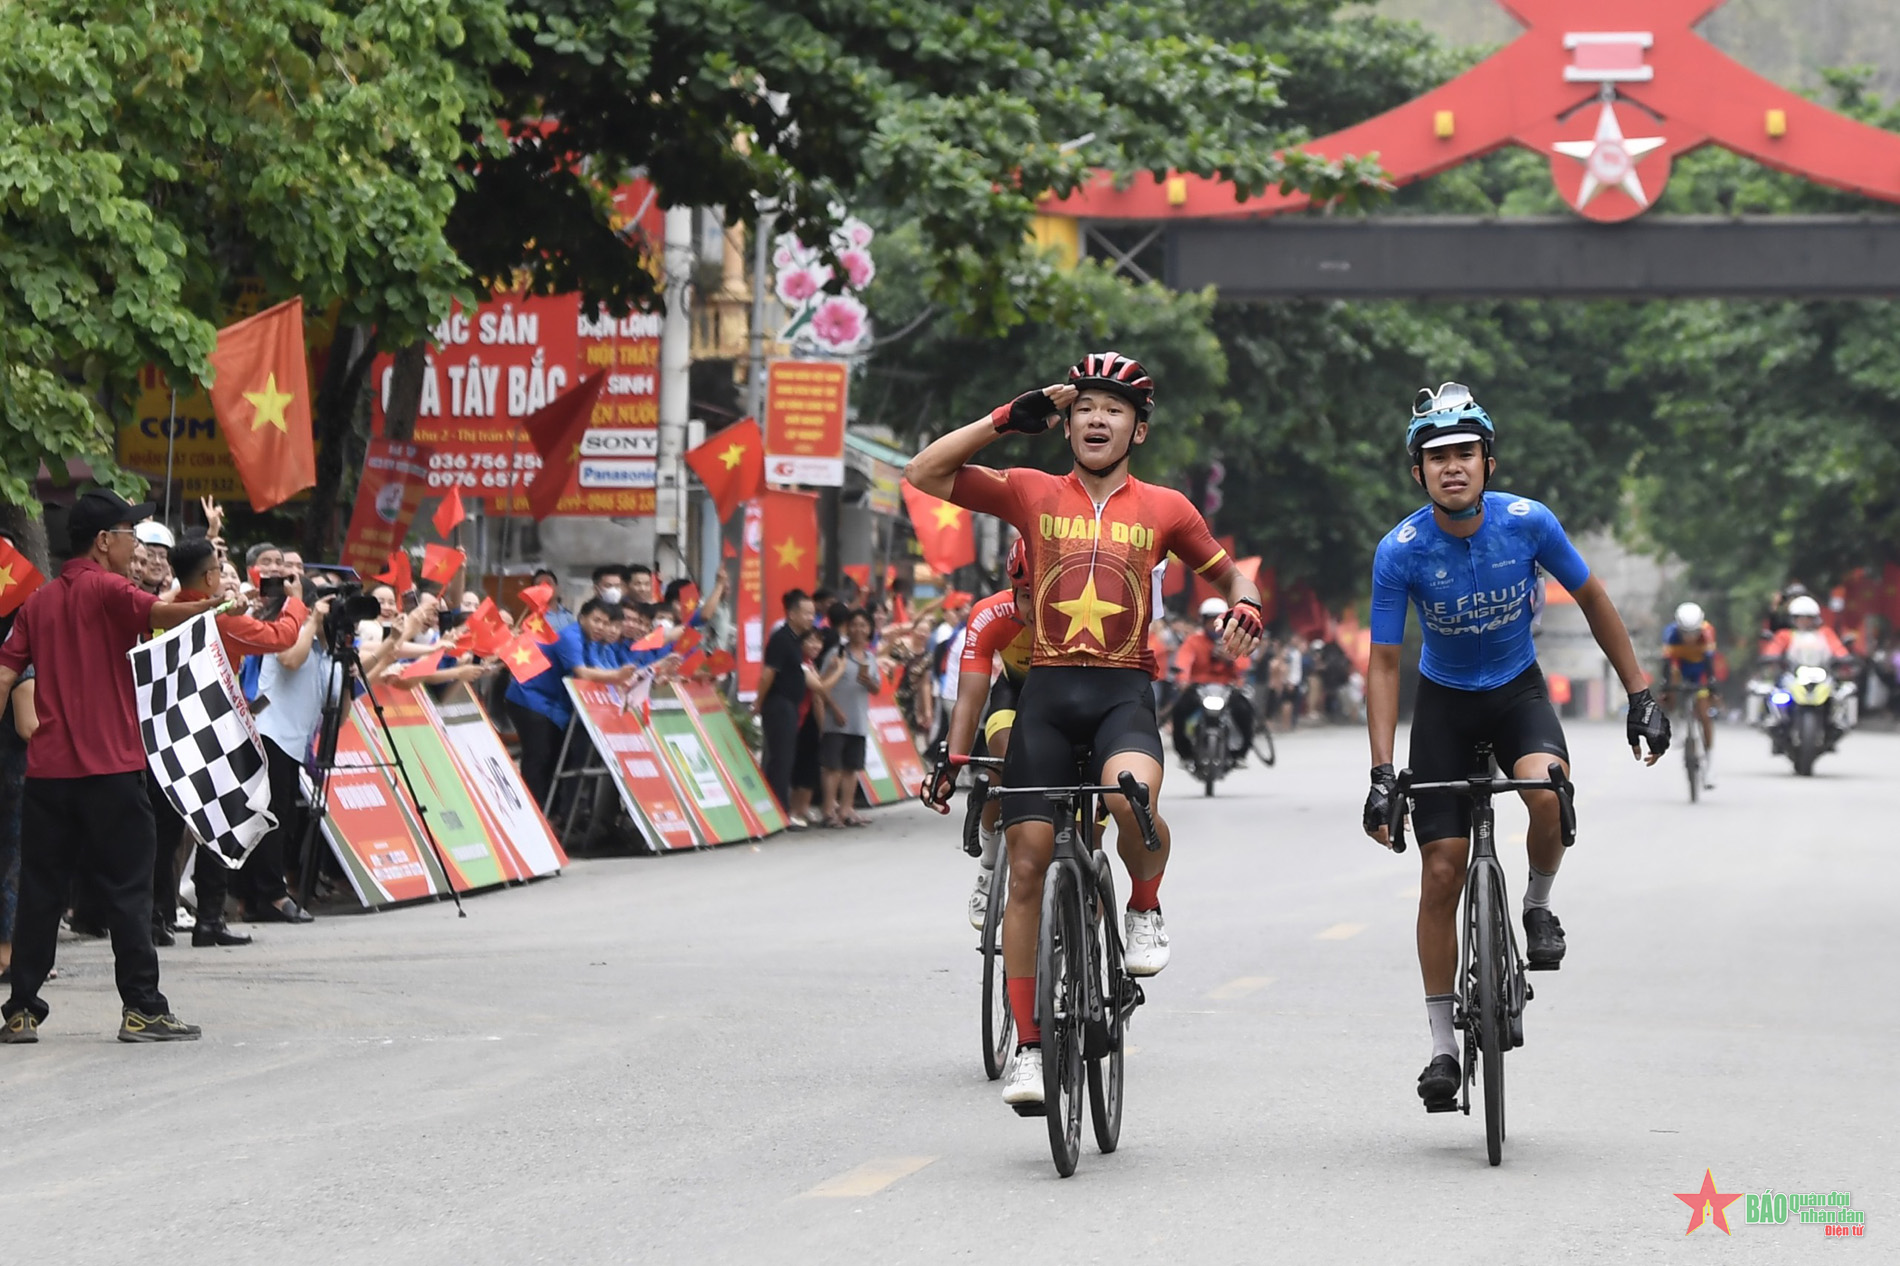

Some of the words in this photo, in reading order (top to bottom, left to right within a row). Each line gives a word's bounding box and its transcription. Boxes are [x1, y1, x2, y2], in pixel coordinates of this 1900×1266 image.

[480, 302, 539, 345] SẢN
[447, 354, 500, 418] TÂY
[507, 347, 567, 418] BẮC
[606, 373, 655, 397] SINH
[140, 415, 215, 440] CƠM
[586, 436, 658, 450] SONY
[428, 453, 467, 469] 036
[470, 453, 507, 469] 756
[427, 471, 477, 487] 0976
[1040, 513, 1101, 541] QUÂN
[1111, 522, 1154, 551] ĐỘI
[1422, 600, 1447, 614] LE
[1456, 577, 1528, 611] FRUIT
[970, 607, 996, 633] MINH
[993, 601, 1016, 618] CITY
[209, 640, 226, 668] NAM
